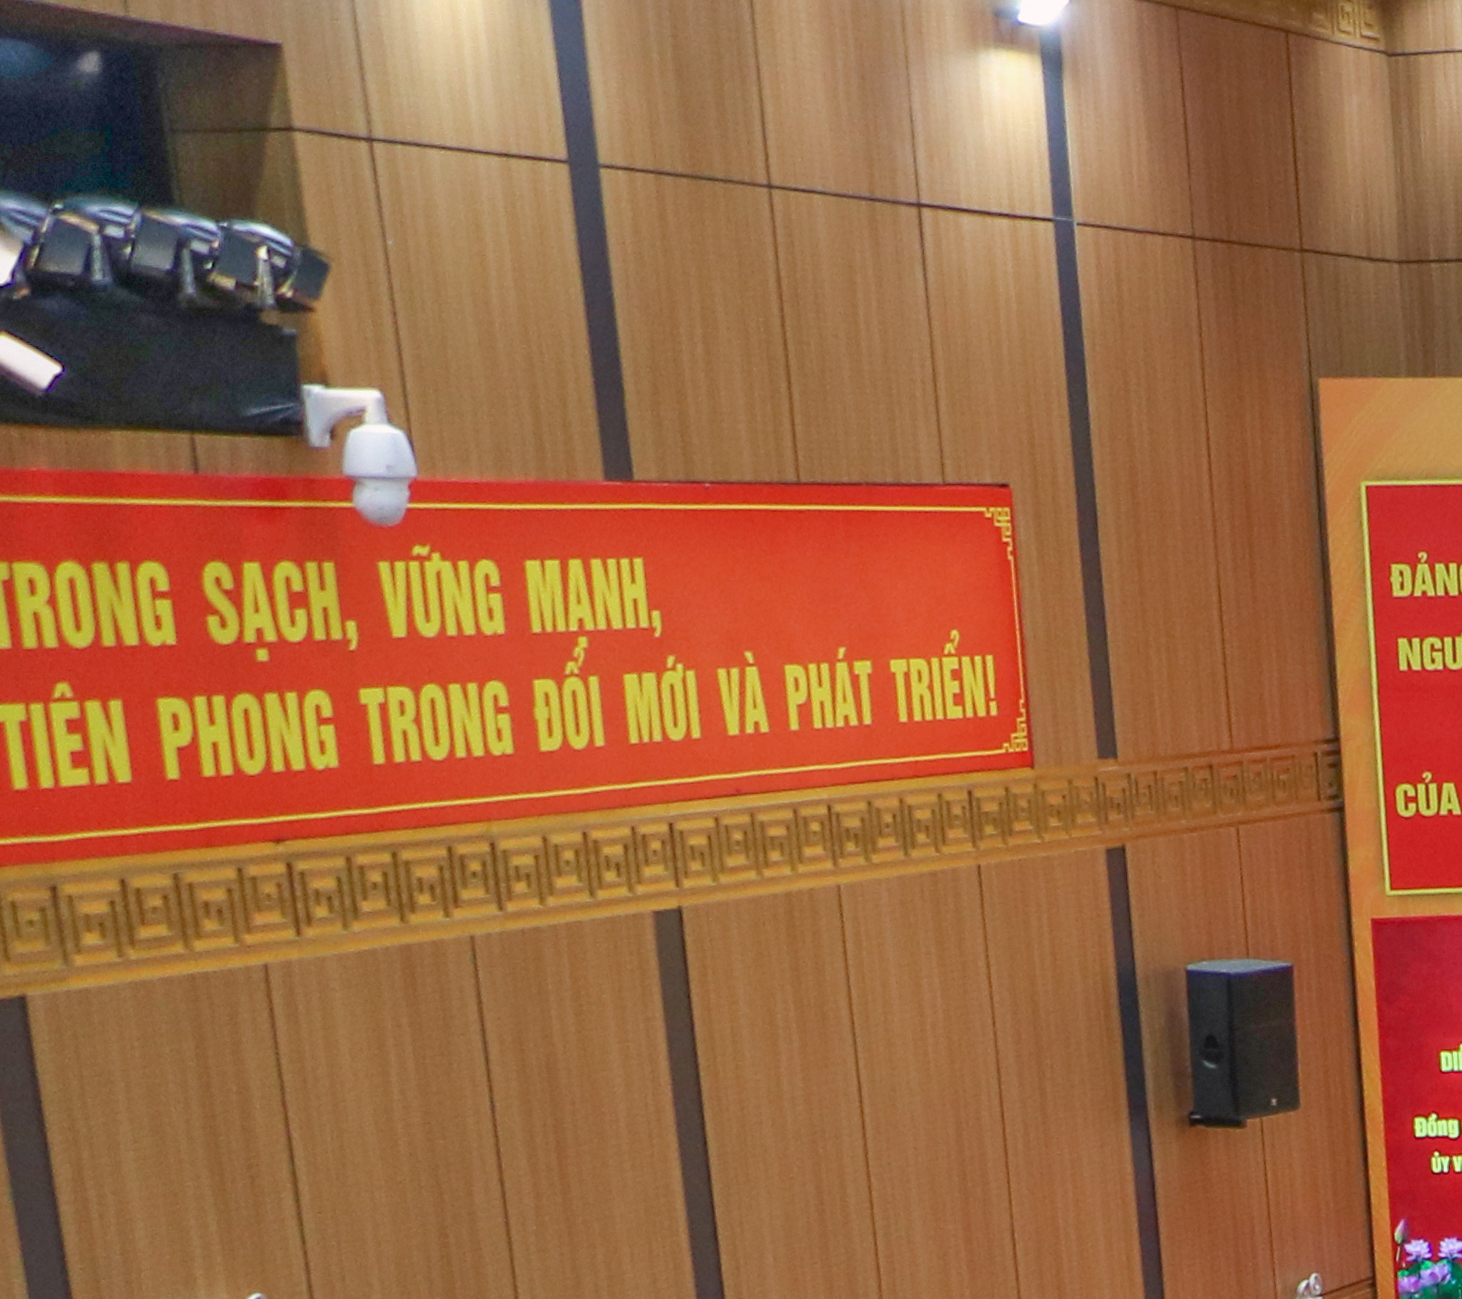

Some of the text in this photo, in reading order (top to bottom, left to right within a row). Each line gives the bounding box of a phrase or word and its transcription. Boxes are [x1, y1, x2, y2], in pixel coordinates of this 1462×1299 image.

[203, 561, 357, 661] SẠCH,
[378, 545, 505, 637] VỮNG
[525, 557, 662, 648] MẠNH,
[0, 630, 997, 789] TIÊN PHONG TRONG ĐỔI MỚI VÀ PHÁT TRIỂN!
[1396, 772, 1461, 817] CỦA
